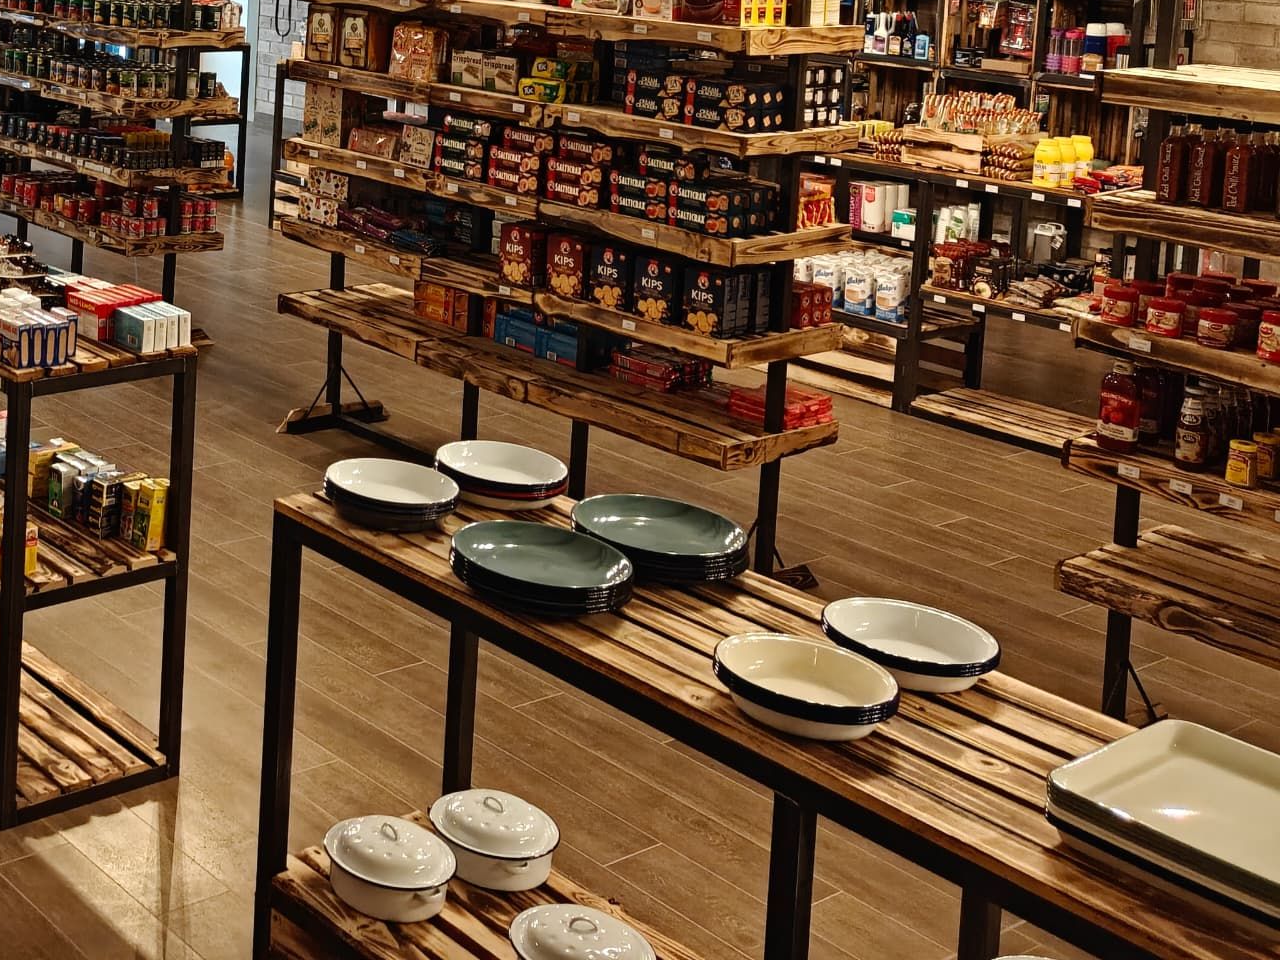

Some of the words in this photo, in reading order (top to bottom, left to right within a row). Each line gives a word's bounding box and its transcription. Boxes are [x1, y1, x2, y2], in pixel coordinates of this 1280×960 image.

[453, 55, 482, 65] crispbread
[484, 60, 515, 71] crispbread
[511, 131, 535, 143] SALTICRAX
[567, 141, 593, 154] SALTICRAX
[497, 150, 521, 163] SALTICRAX
[556, 162, 582, 176] SALTICRAX
[648, 157, 675, 171] SALTICRAX
[496, 170, 520, 183] SALTICRAX
[618, 175, 646, 189] SALTICRAX
[555, 182, 580, 196] SALTICRAX
[677, 188, 706, 202] SALTICRAX
[619, 196, 646, 211] SALTICRAX
[677, 209, 706, 224] SALTICRAX
[505, 241, 524, 256] KIPS
[554, 253, 575, 268] KIPS
[597, 264, 619, 279] KIPS
[641, 276, 663, 292] KIPS
[691, 288, 714, 304] KIPS
